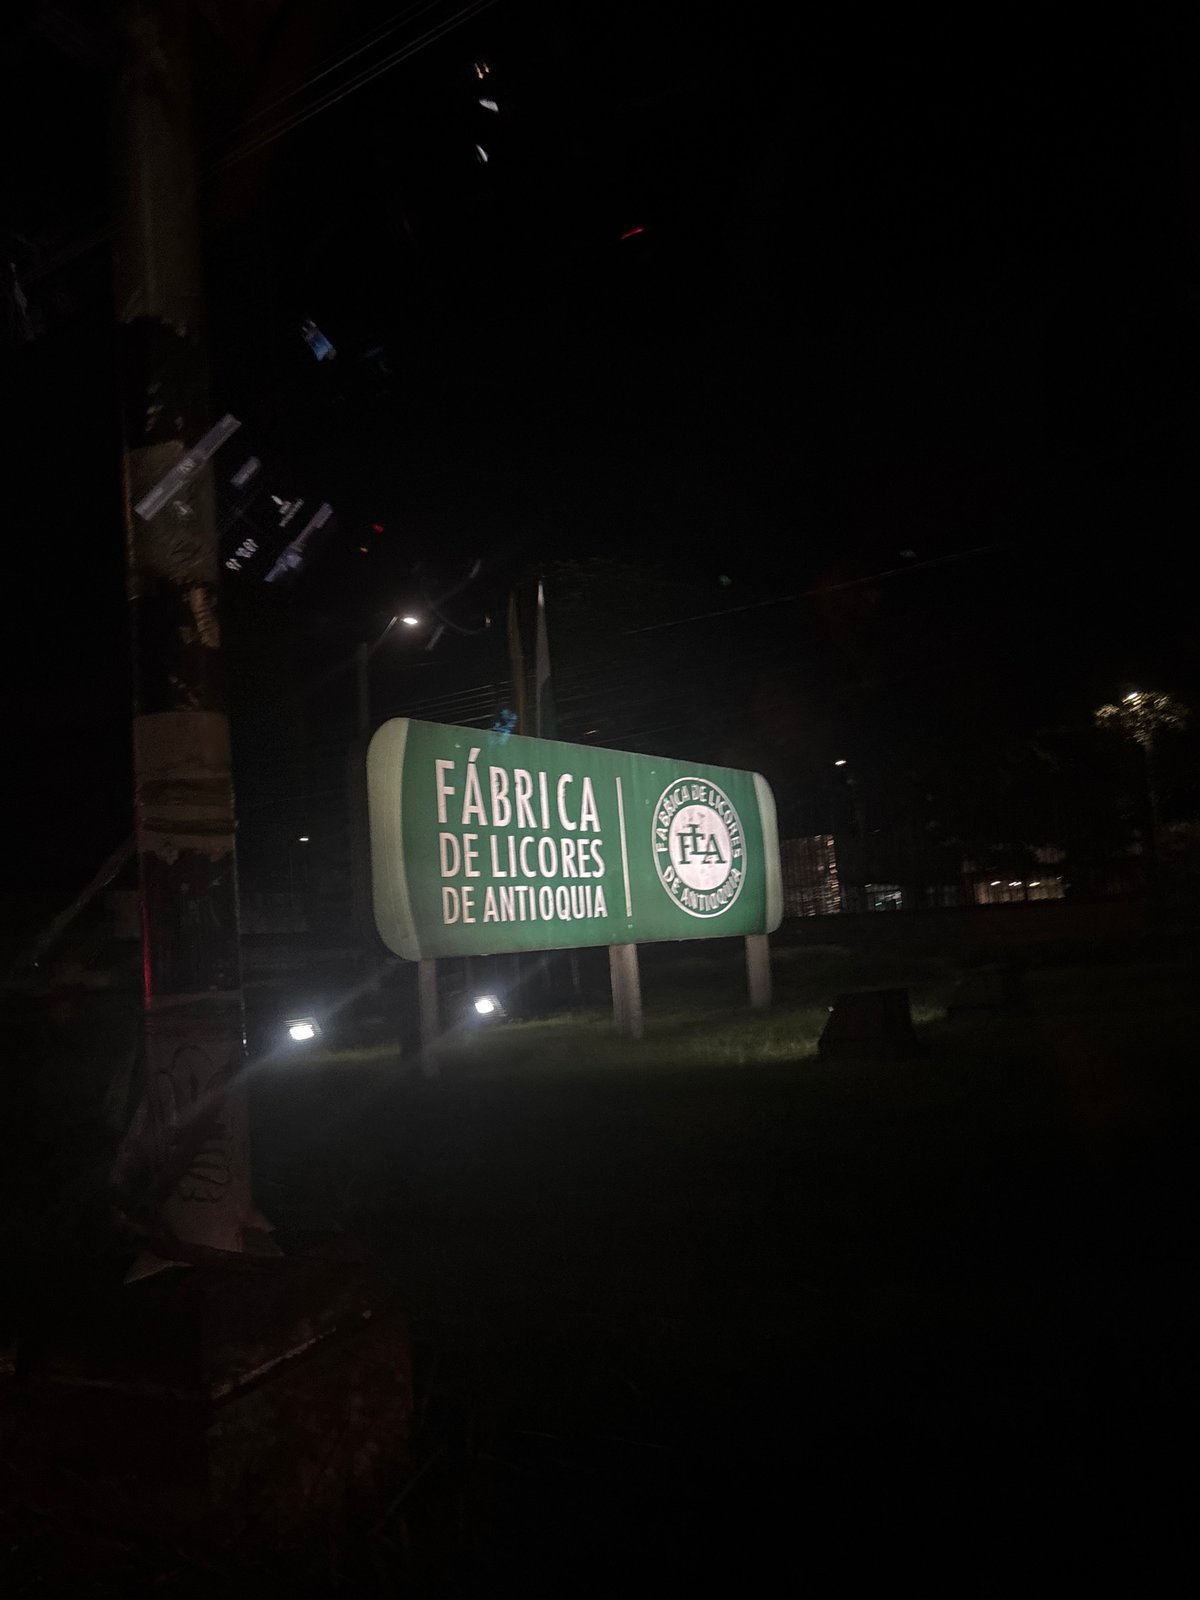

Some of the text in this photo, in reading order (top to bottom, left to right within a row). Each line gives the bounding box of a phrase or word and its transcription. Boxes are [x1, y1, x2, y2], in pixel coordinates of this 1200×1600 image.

[435, 748, 601, 832] FÁBRICA
[691, 784, 707, 802] DE
[439, 832, 606, 878] DE LICORES
[663, 865, 682, 894] DE
[441, 884, 608, 925] DE ANTIOQUIA
